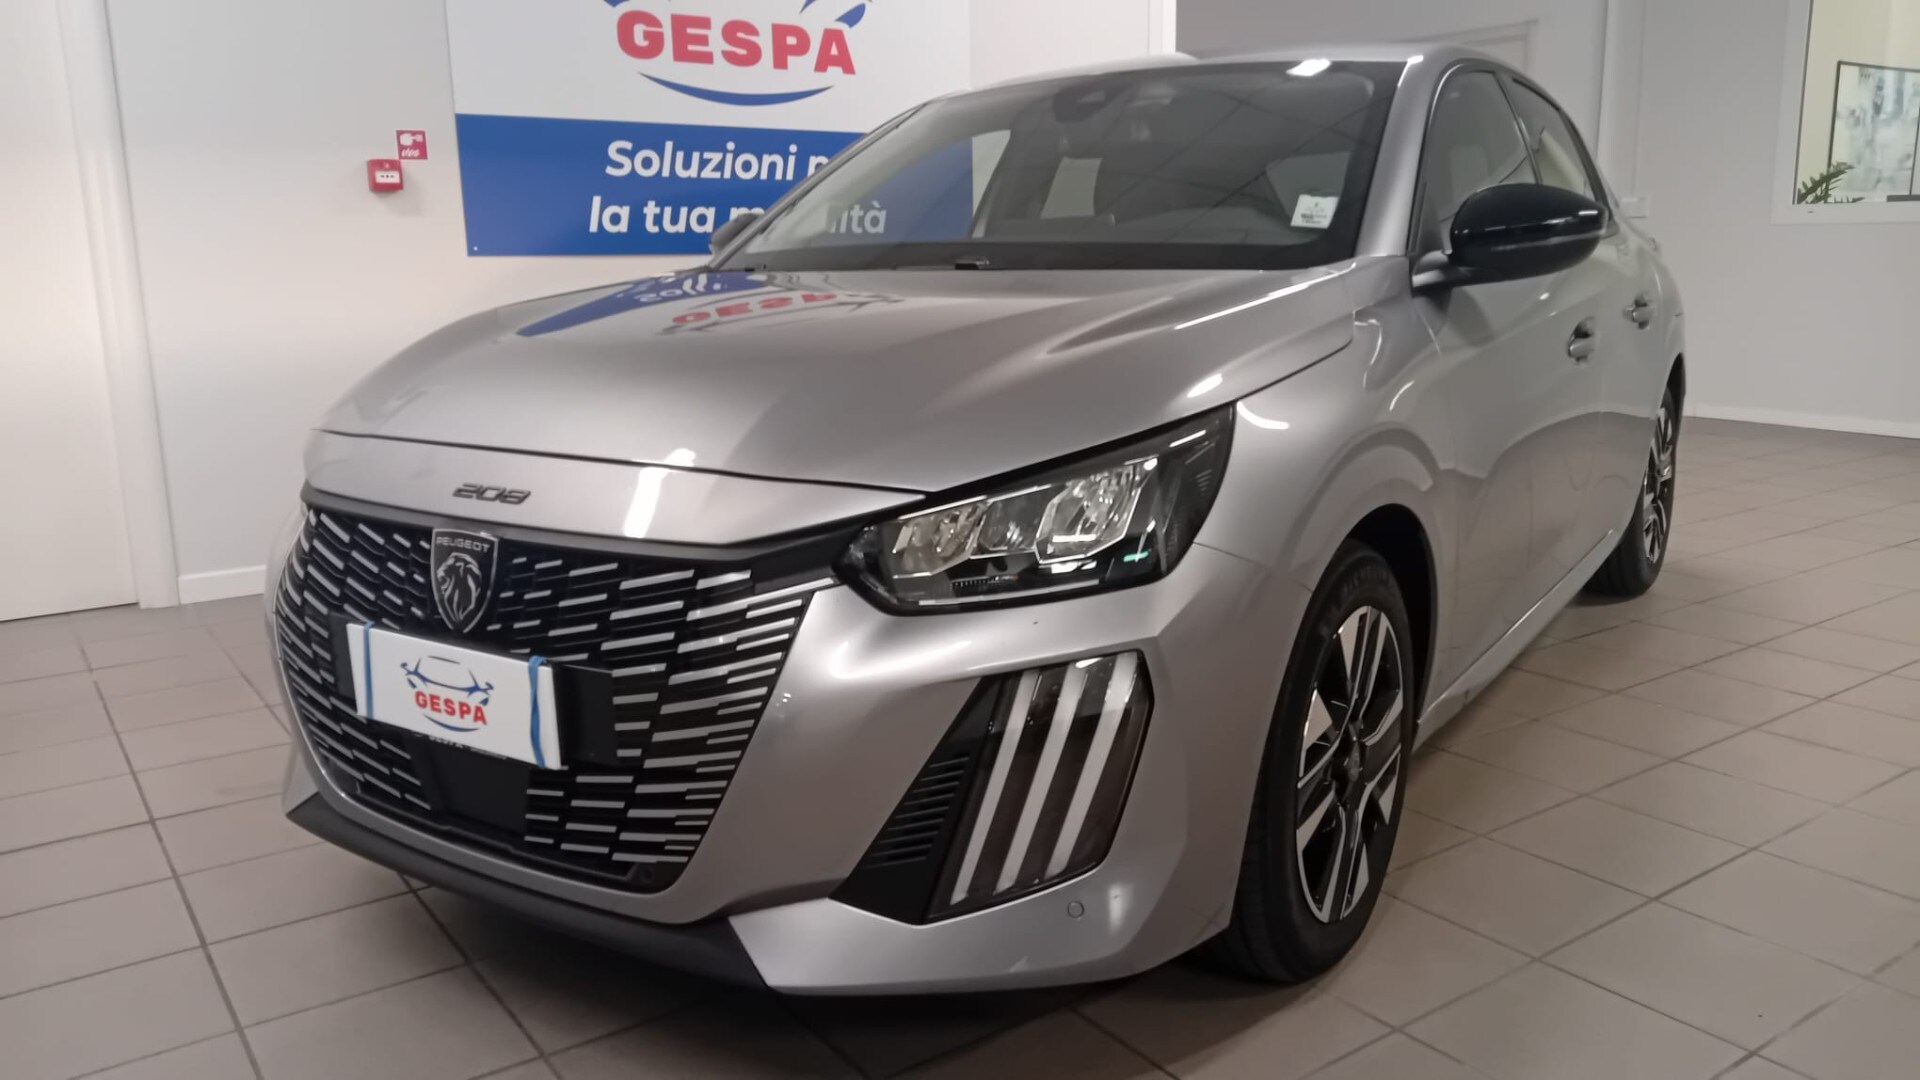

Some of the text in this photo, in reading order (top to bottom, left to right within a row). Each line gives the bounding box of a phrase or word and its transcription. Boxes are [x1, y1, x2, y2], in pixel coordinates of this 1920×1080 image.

[616, 9, 856, 76] GESPA
[605, 140, 798, 181] Soluzioni
[589, 195, 630, 233] la
[643, 200, 716, 234] tua
[452, 483, 532, 505] 208
[436, 536, 491, 553] PEUGEOT
[414, 689, 488, 726] GESPA
